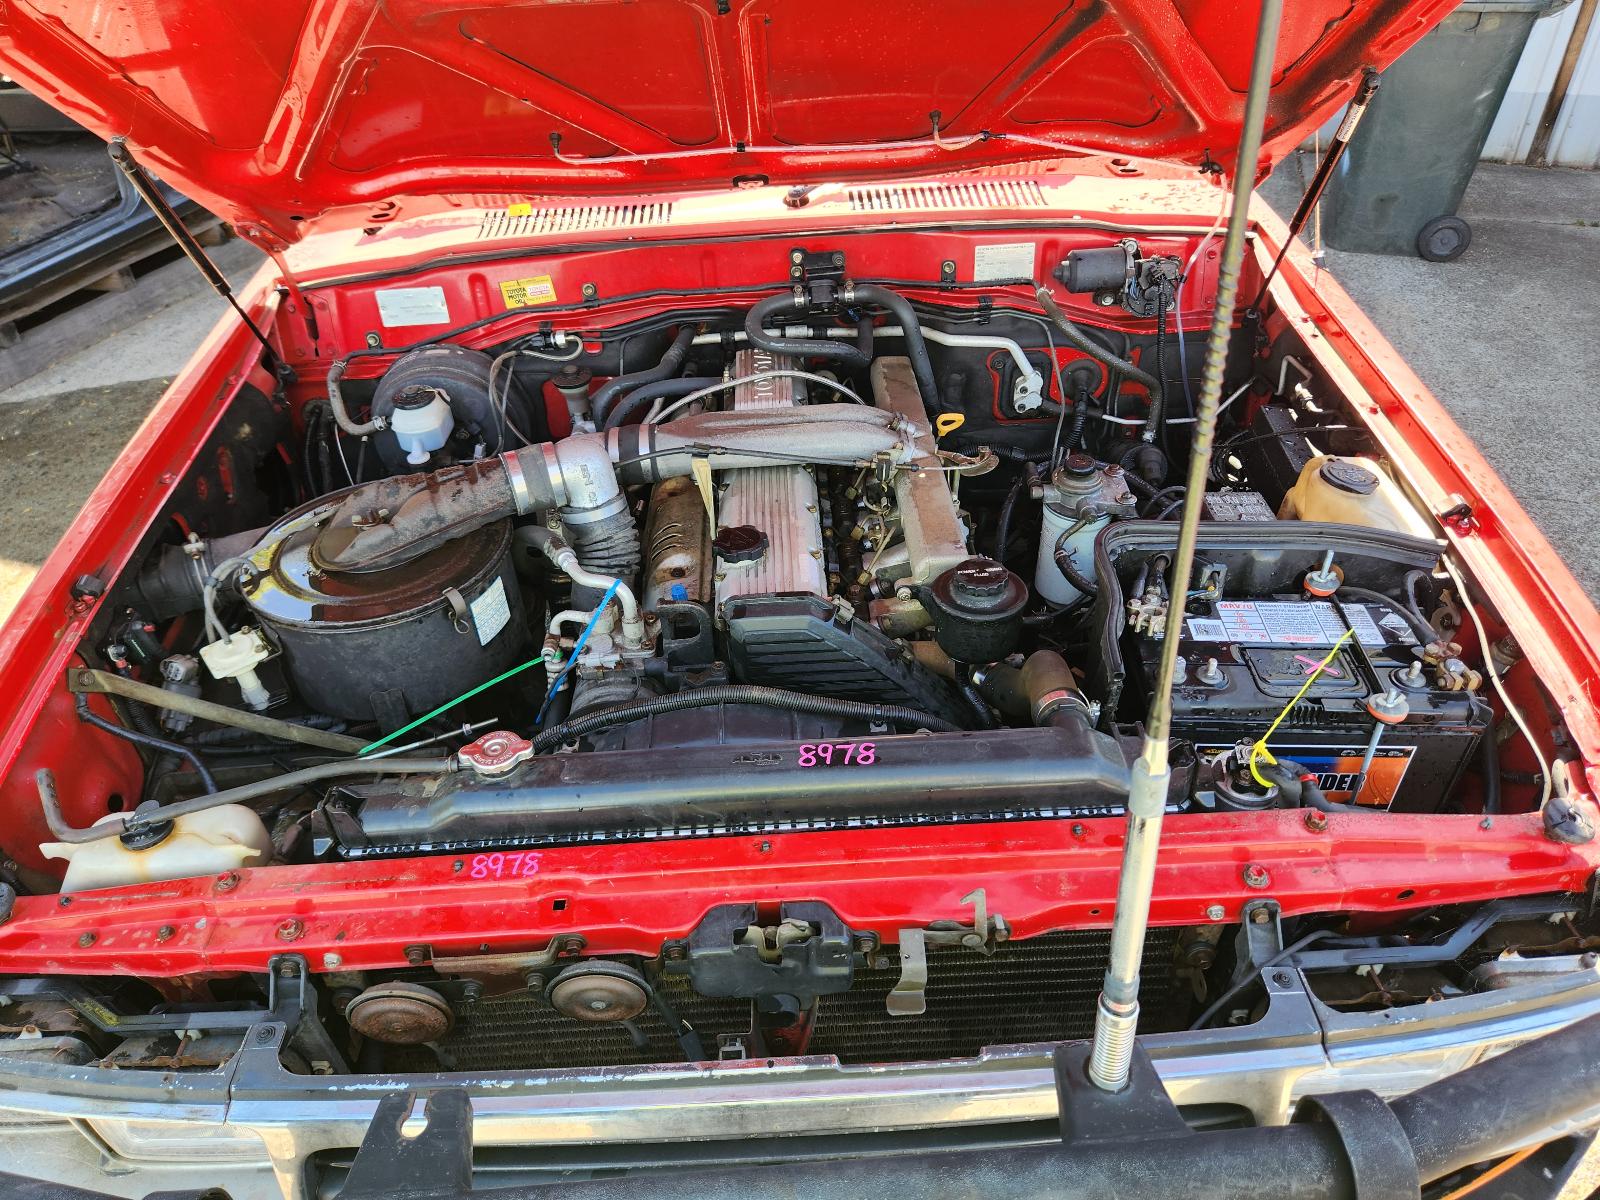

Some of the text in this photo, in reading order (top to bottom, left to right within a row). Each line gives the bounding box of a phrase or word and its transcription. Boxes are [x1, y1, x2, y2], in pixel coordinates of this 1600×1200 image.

[505, 287, 527, 295] TOYOTA
[507, 293, 528, 301] MOTOR
[798, 742, 876, 767] 8978
[470, 852, 543, 878] 8978
